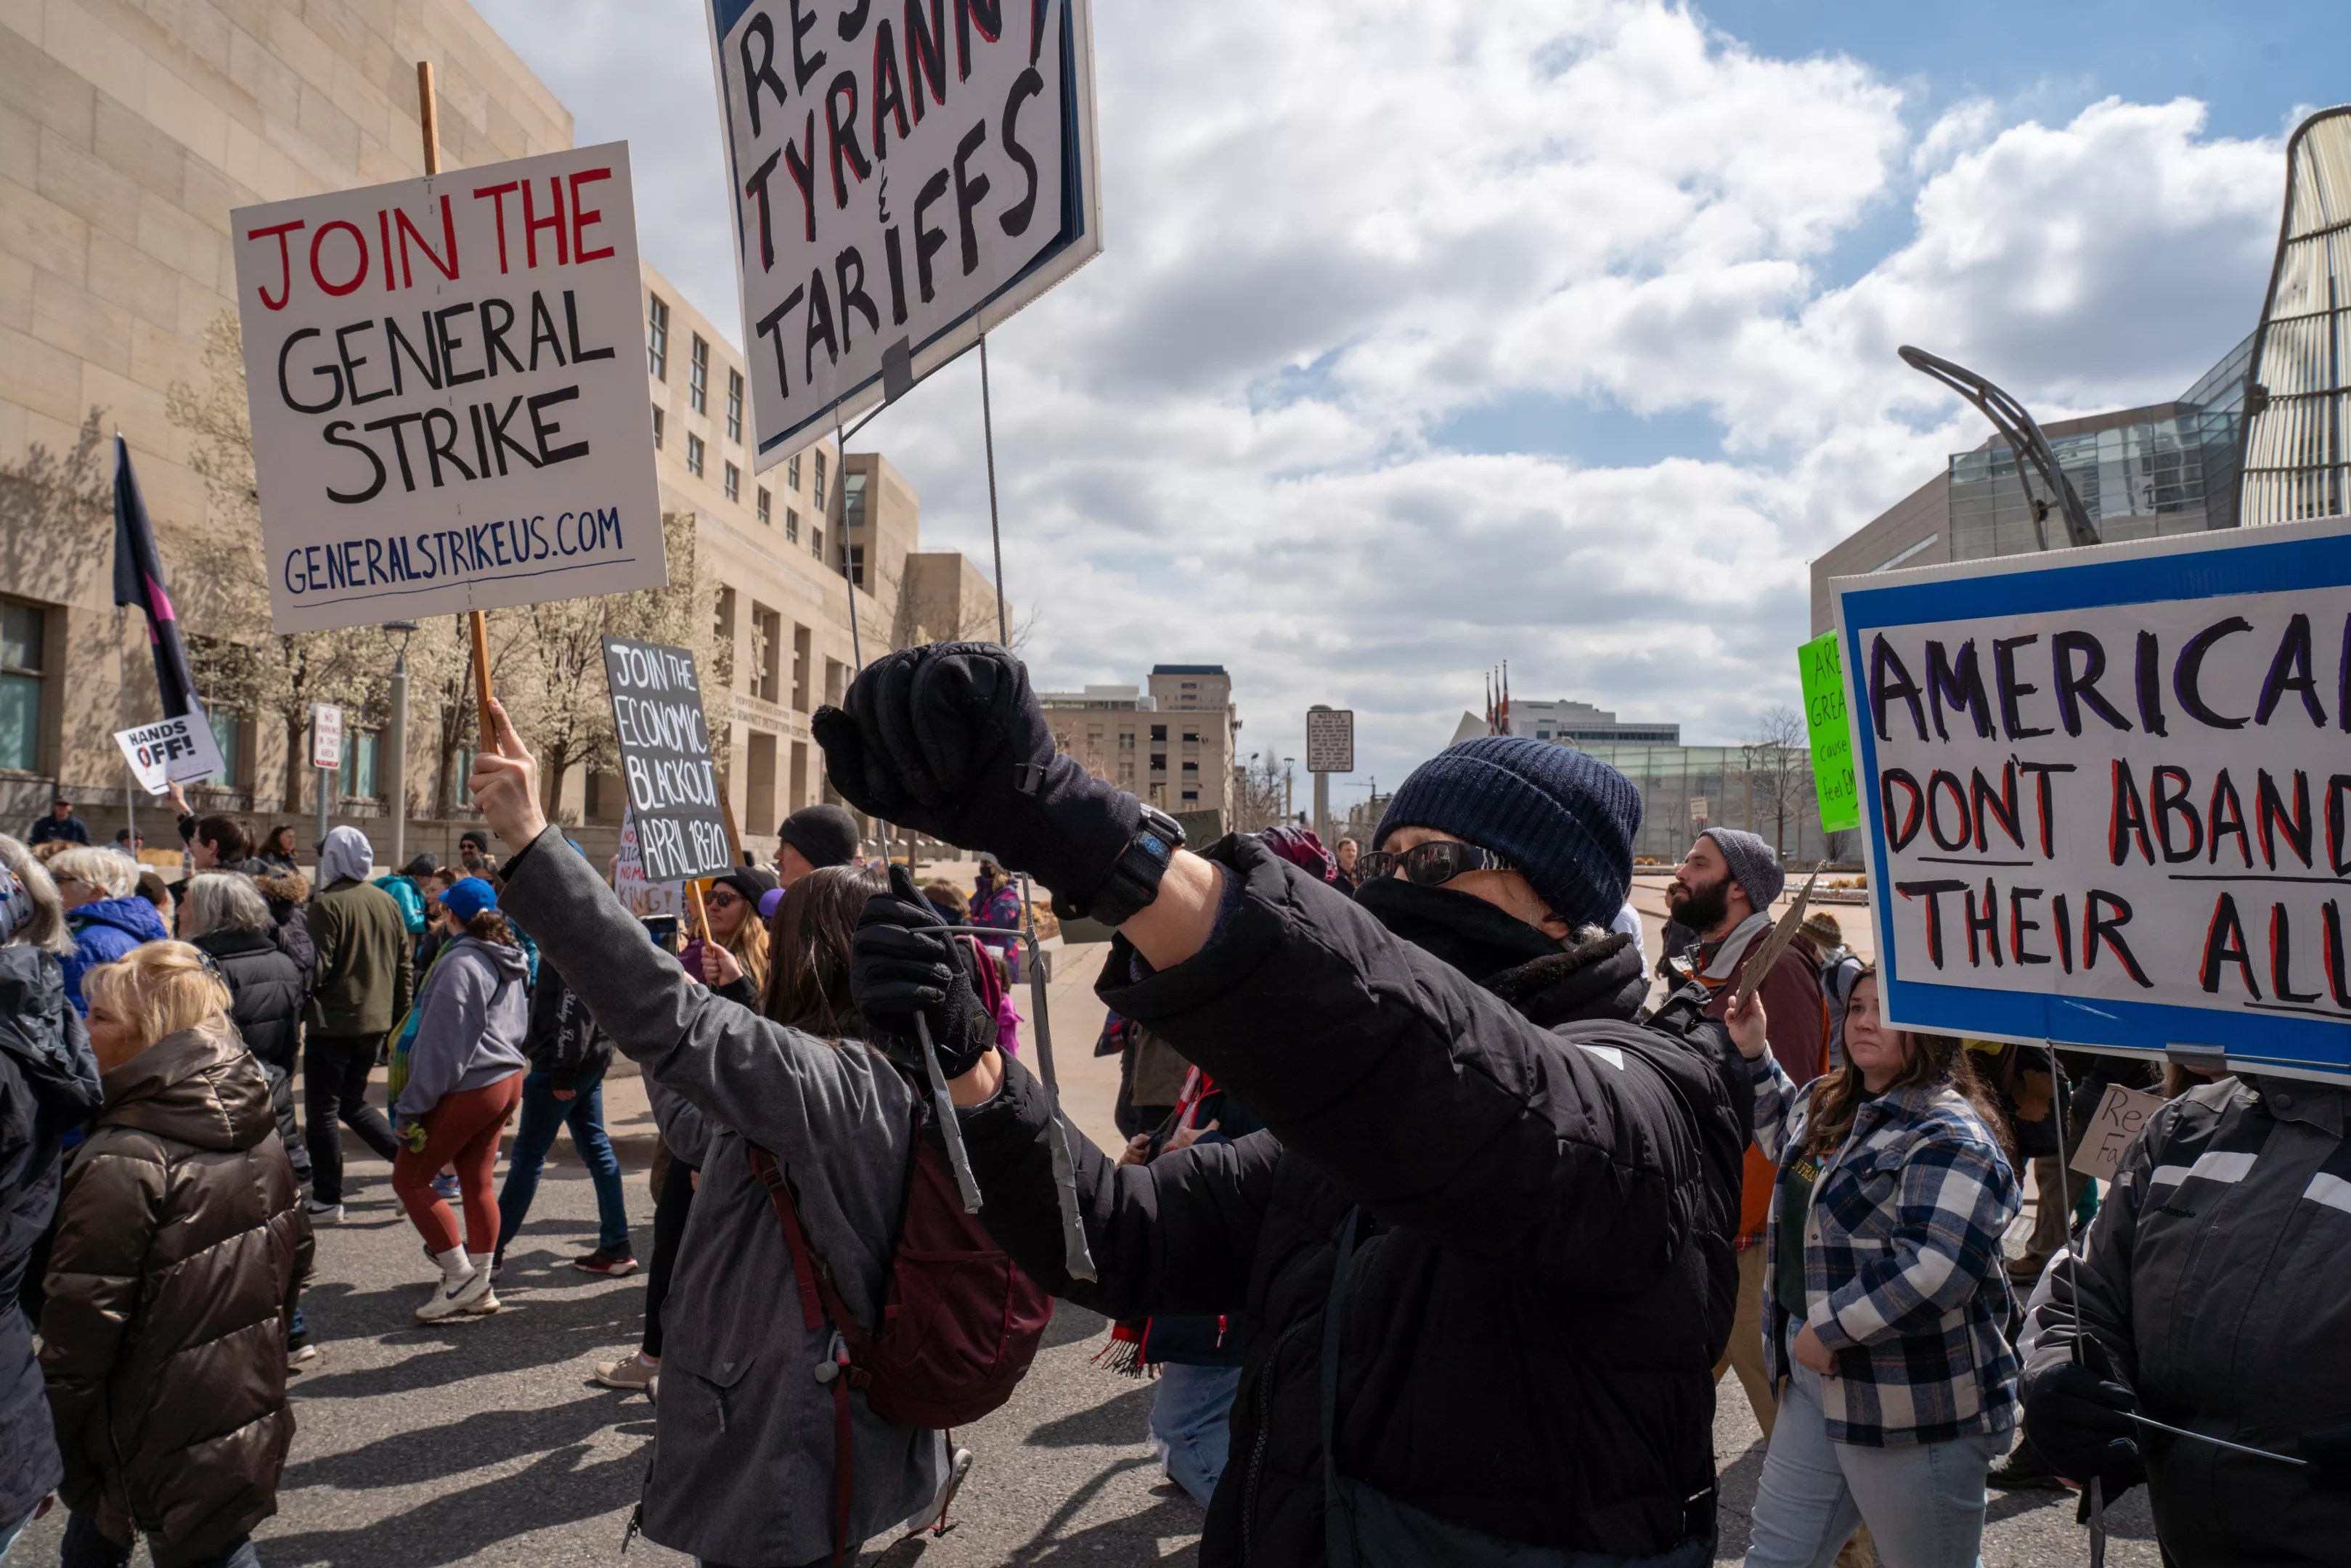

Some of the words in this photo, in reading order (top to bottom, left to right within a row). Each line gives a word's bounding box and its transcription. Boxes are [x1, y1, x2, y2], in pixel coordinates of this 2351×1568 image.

[248, 195, 460, 311] JOIN
[473, 167, 616, 275] THE
[756, 67, 1045, 401] TARIFFS
[278, 290, 616, 415] GENERAL
[322, 385, 590, 505] STRIKE
[285, 507, 624, 595] GENERALSTRIKEUS.COM
[610, 644, 669, 692] JOIN
[666, 653, 697, 692] THE
[1815, 638, 1842, 686] ARE
[128, 720, 187, 746] HANDS
[137, 735, 196, 768] OFF!
[615, 695, 707, 755] ECONOMIC
[1820, 738, 1848, 762] cause
[627, 755, 717, 812] BLACKOUT
[1823, 776, 1843, 803] feel
[1881, 753, 2077, 860] DON'T
[642, 818, 698, 878] APRIL
[1895, 876, 2155, 988] THEIR
